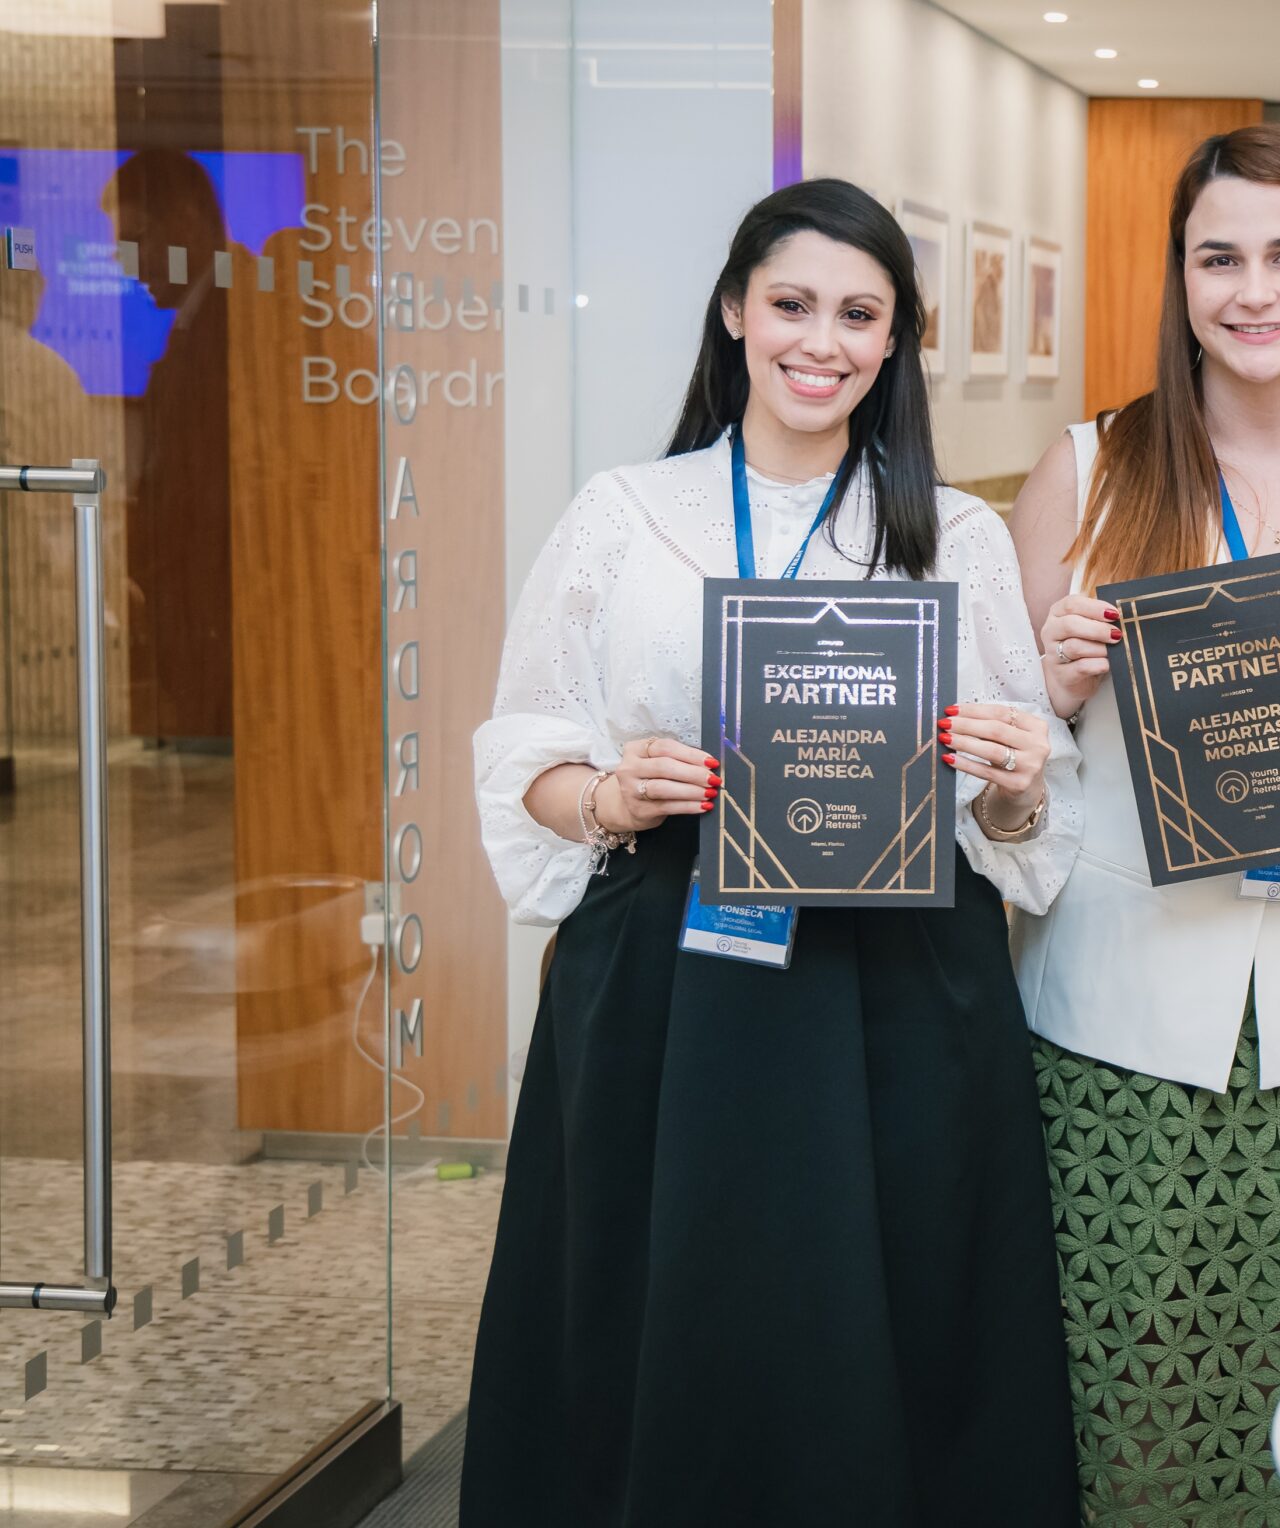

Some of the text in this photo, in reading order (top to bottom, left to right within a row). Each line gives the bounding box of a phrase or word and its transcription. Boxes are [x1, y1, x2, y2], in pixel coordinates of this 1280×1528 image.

[296, 126, 406, 176] The
[299, 204, 499, 254] Steven
[15, 243, 33, 254] PUSH
[763, 664, 897, 680] EXCEPTIONAL
[764, 683, 897, 705] PARTNER
[771, 729, 887, 744] ALEJANDRA
[798, 744, 861, 761] MARÍA
[784, 764, 874, 778] FONSECA
[1250, 768, 1279, 778] Young
[825, 804, 857, 813] Young
[825, 812, 867, 821] Partners
[825, 820, 862, 829] Retreat
[720, 905, 763, 919] FONSECA
